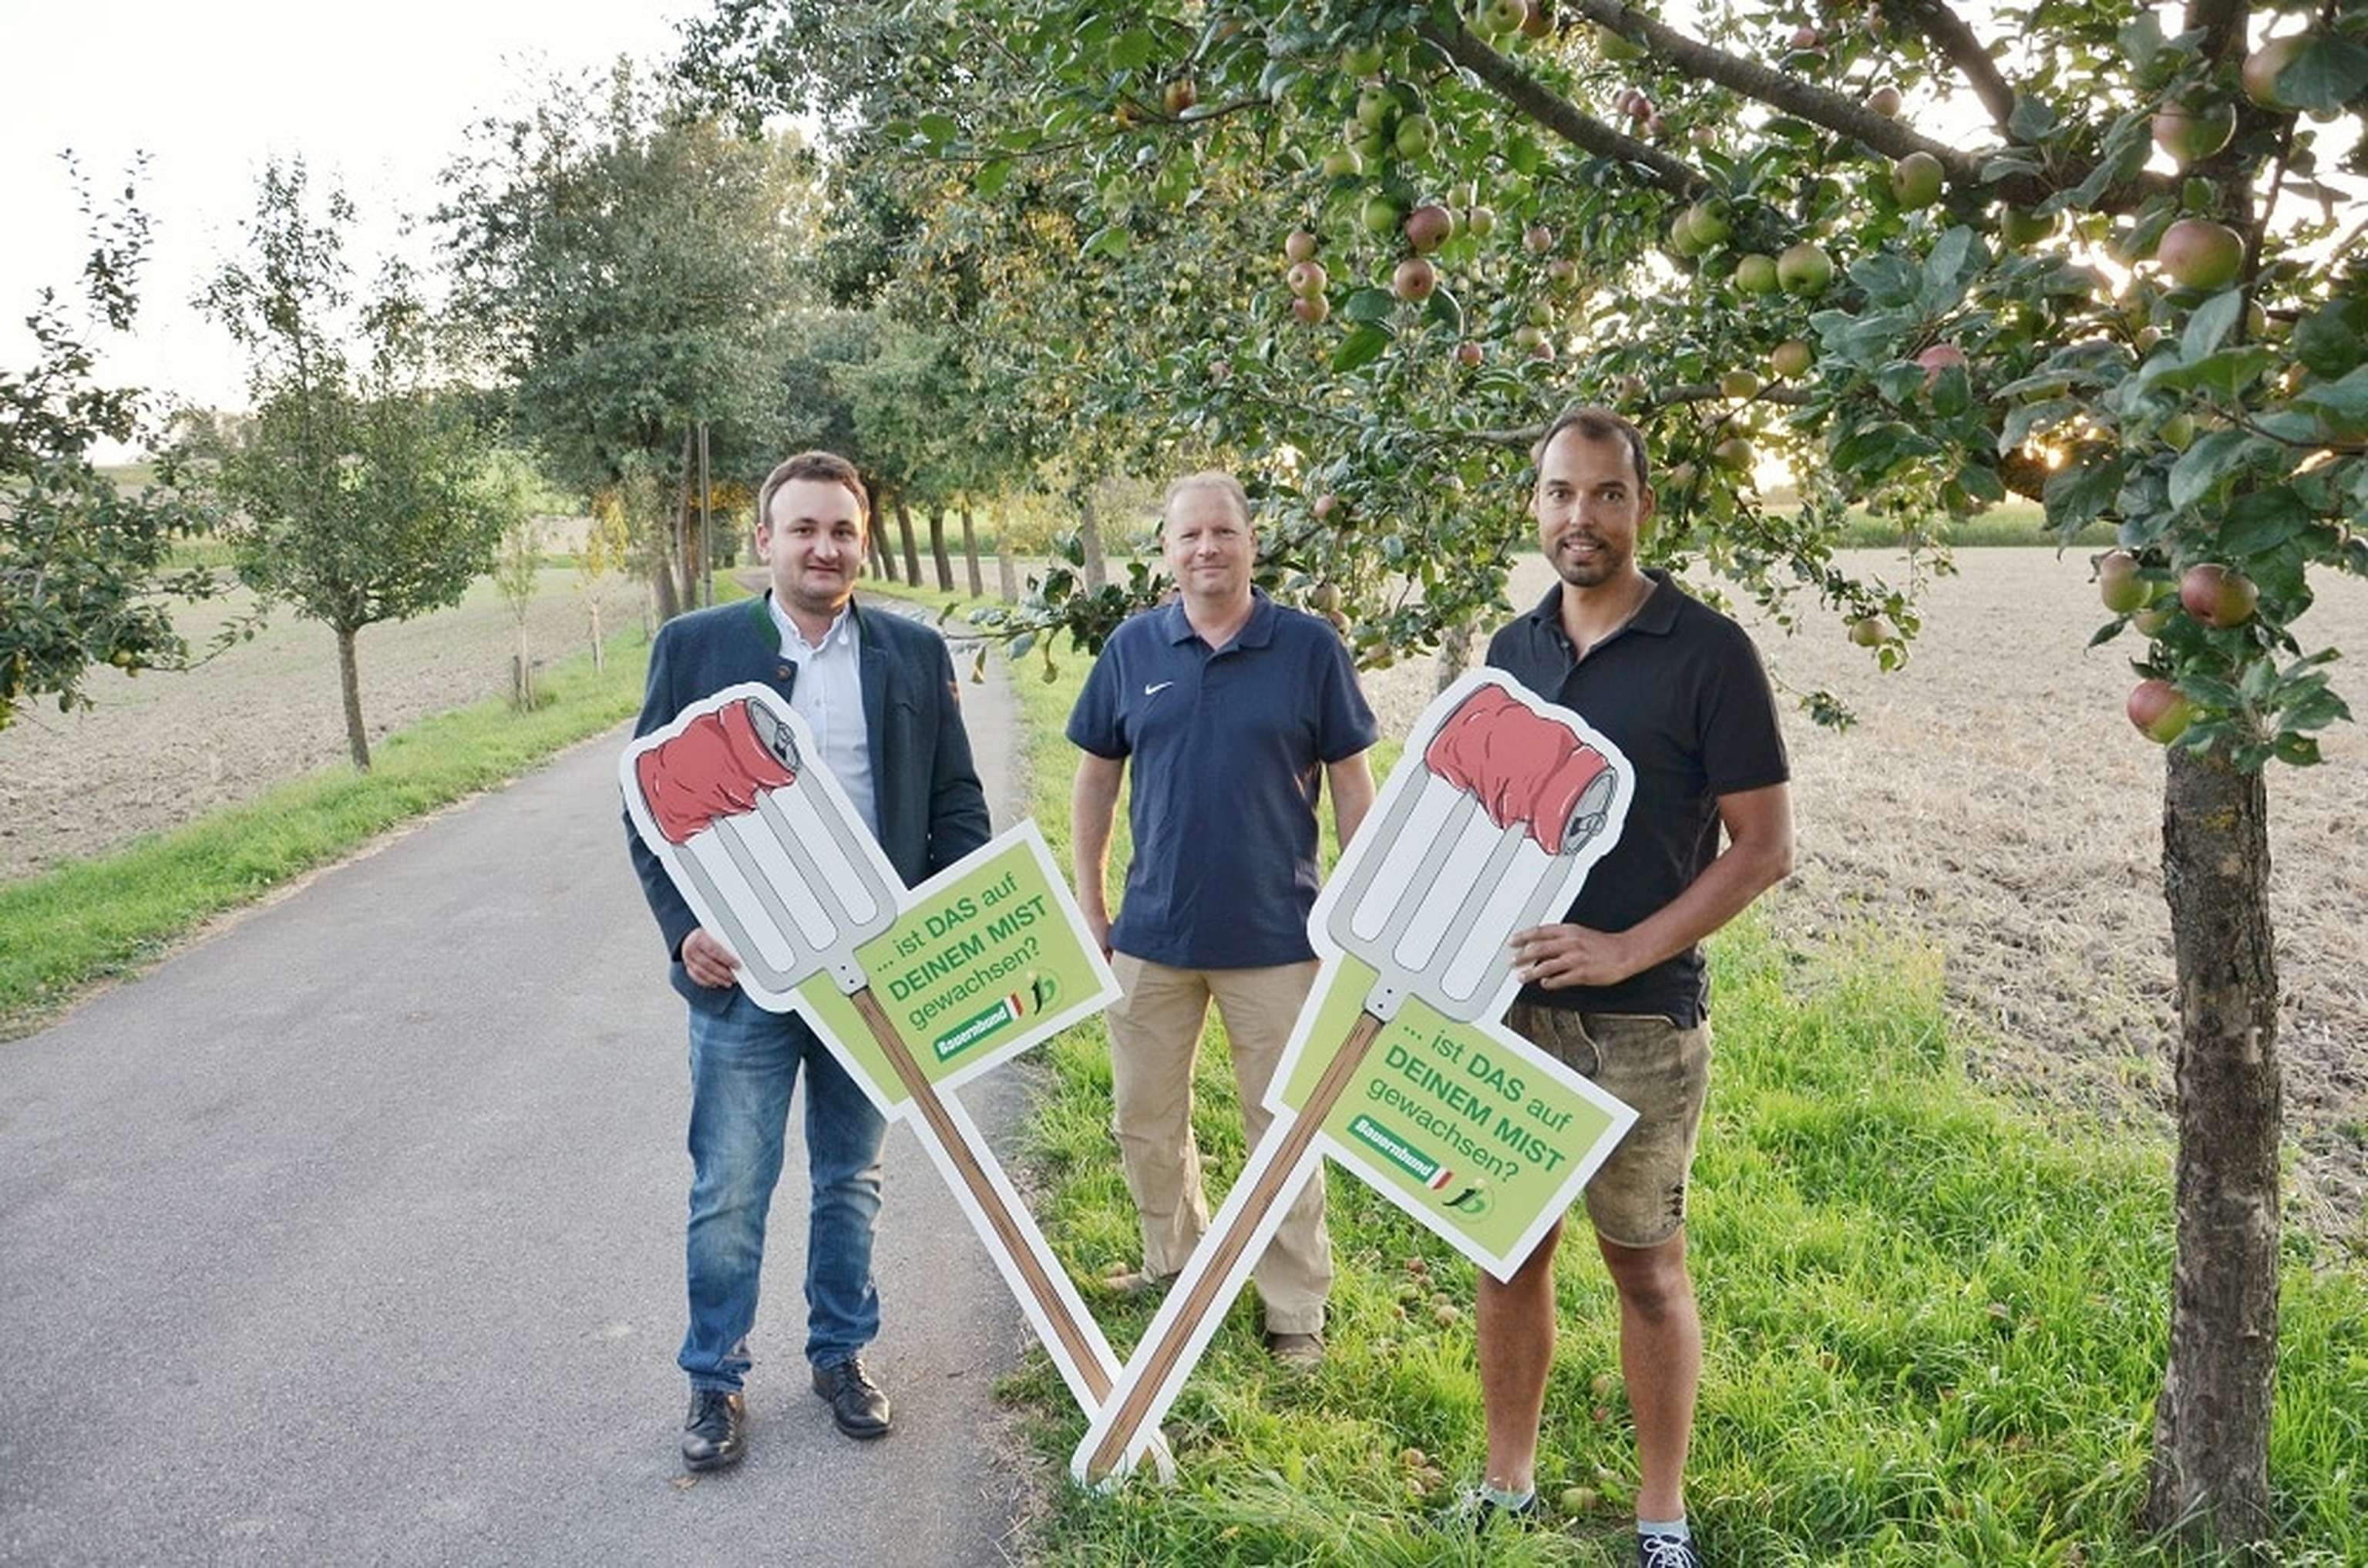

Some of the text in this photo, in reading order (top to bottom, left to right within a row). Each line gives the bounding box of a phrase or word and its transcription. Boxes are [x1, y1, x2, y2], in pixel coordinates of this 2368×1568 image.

[888, 894, 1047, 1001] DEINEM MIST
[893, 930, 926, 958] ist
[925, 898, 978, 938] DAS
[981, 872, 1018, 907] auf
[909, 937, 1041, 1031] gewachsen?
[1367, 1078, 1520, 1183] gewachsen?
[1385, 1045, 1566, 1173] DEINEM MIST
[1431, 1029, 1465, 1064] ist
[1467, 1054, 1525, 1102] DAS
[1526, 1097, 1573, 1132] auf
[1355, 1119, 1435, 1177] Bauernbund
